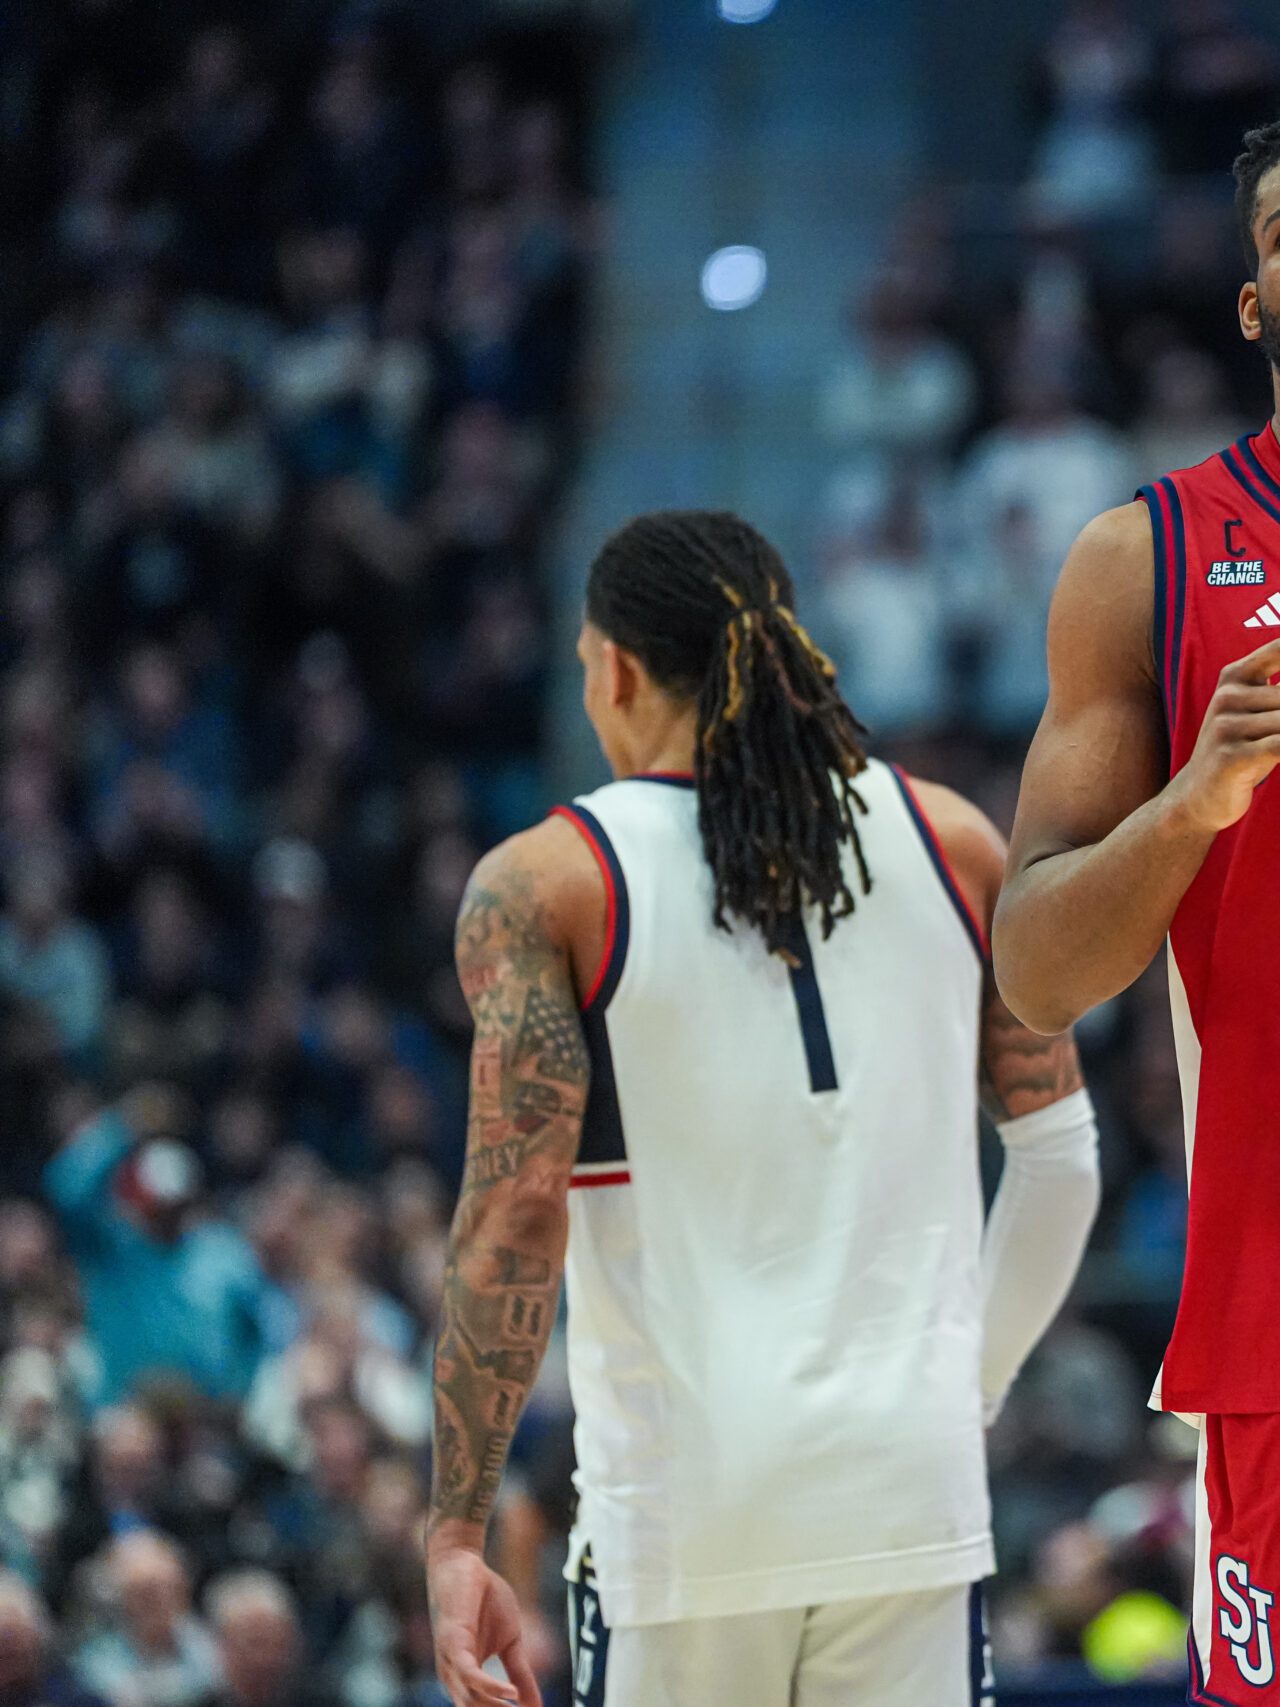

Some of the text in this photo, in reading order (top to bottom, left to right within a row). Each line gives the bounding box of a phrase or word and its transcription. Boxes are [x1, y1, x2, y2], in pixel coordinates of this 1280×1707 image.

[1224, 520, 1246, 557] C
[1211, 560, 1262, 574] BE THE
[1207, 571, 1265, 586] CHANGE
